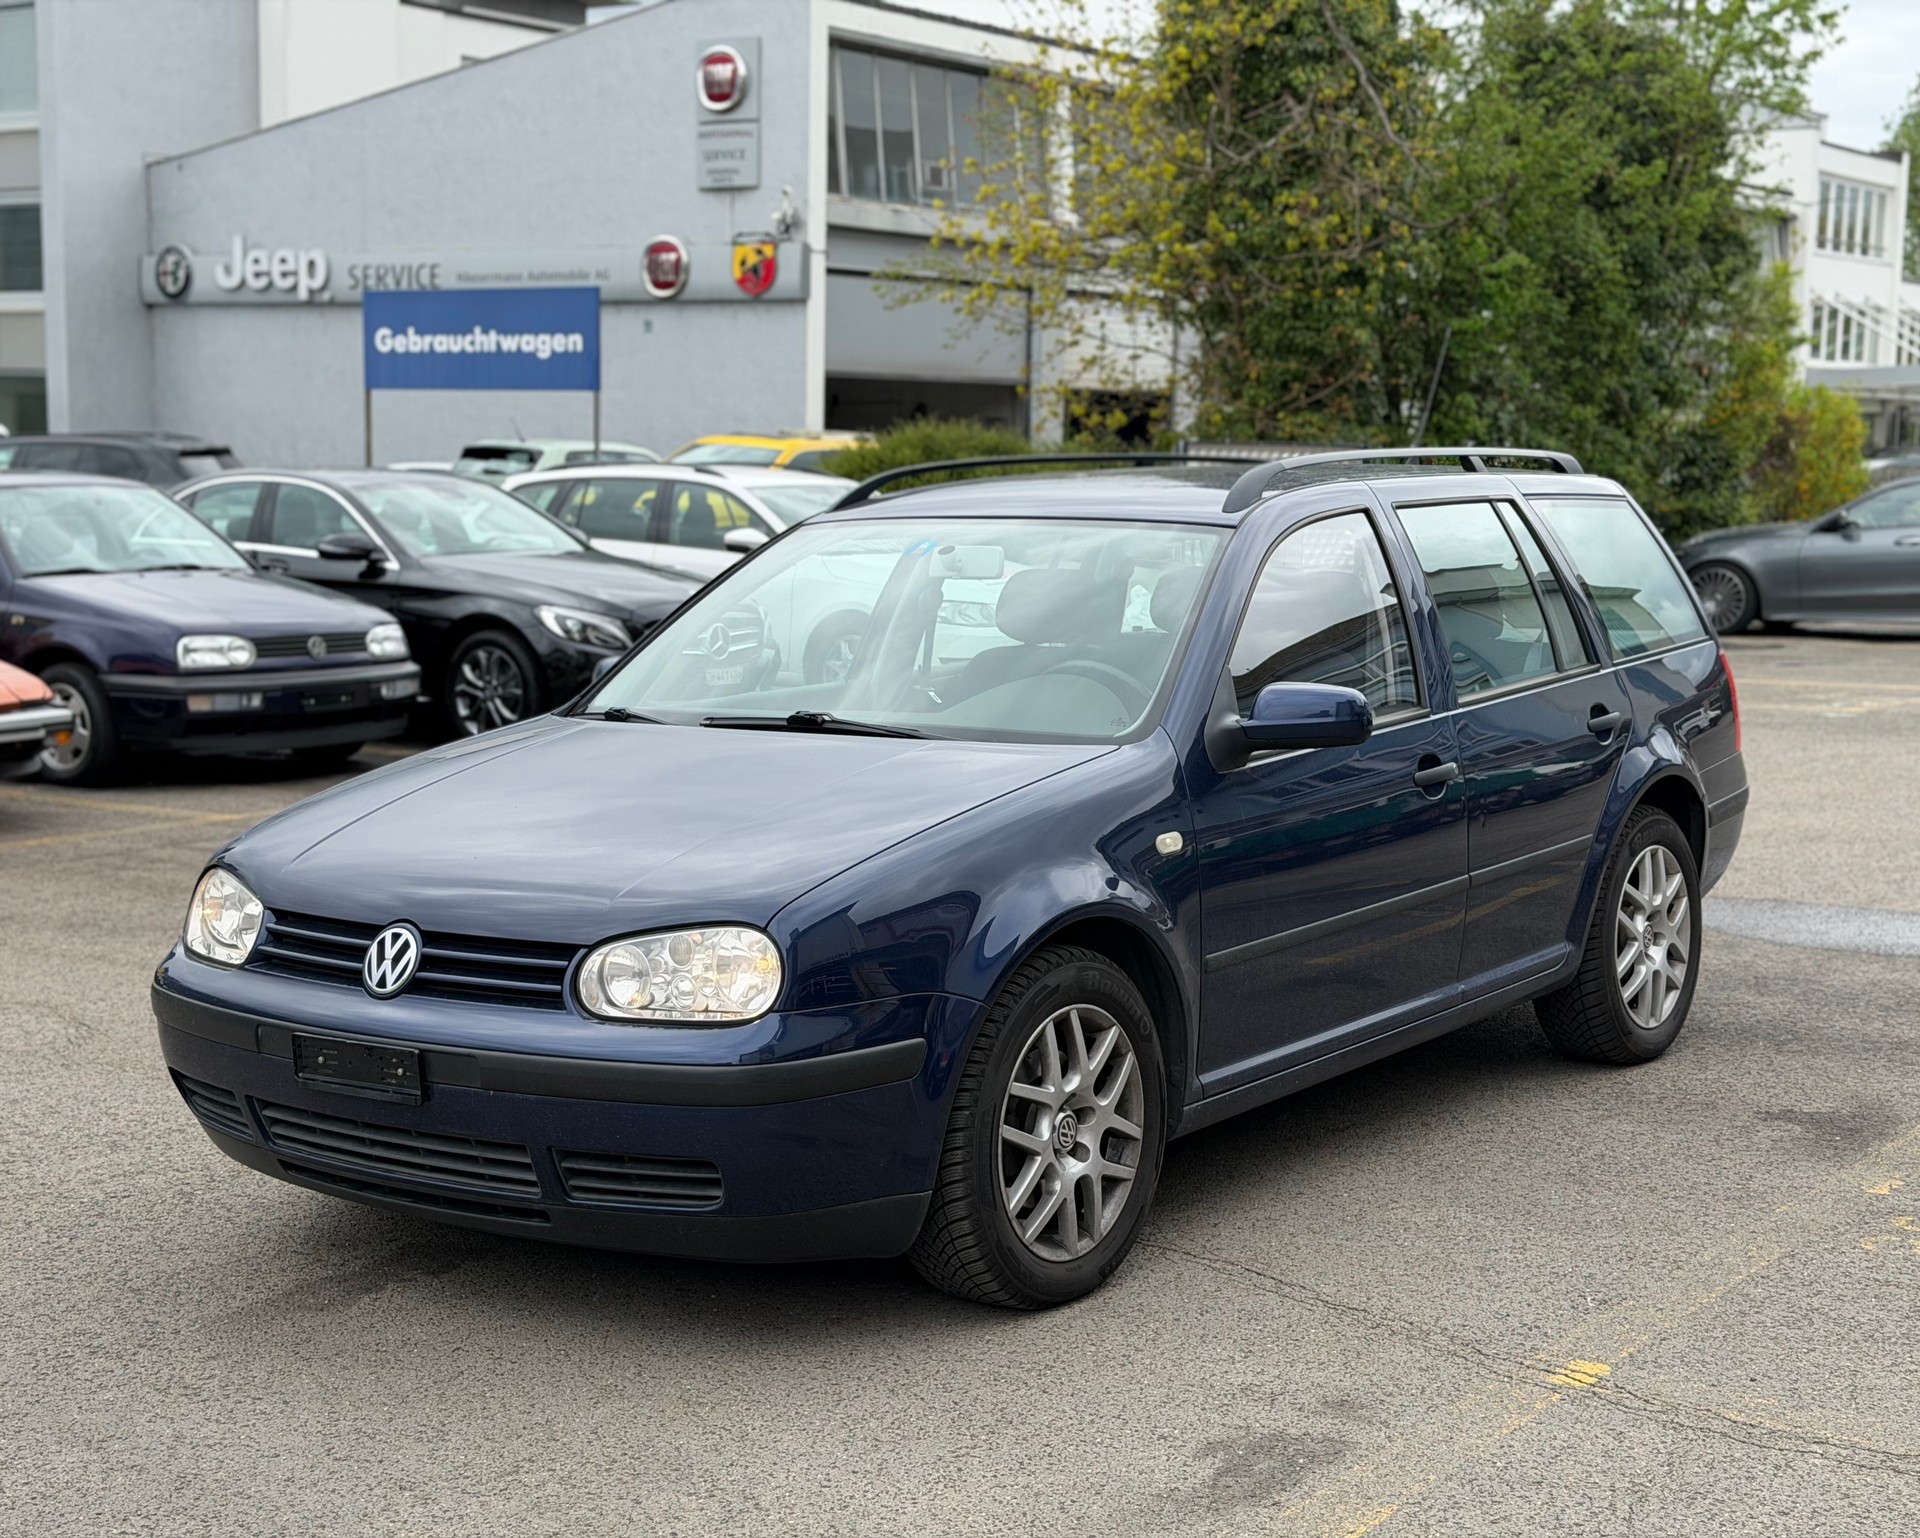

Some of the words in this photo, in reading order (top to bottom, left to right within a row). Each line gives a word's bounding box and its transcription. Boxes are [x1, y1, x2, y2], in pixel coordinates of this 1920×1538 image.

[214, 234, 328, 301] Jeep
[347, 262, 441, 291] SERVICE
[374, 325, 584, 360] Gebrauchtwagen
